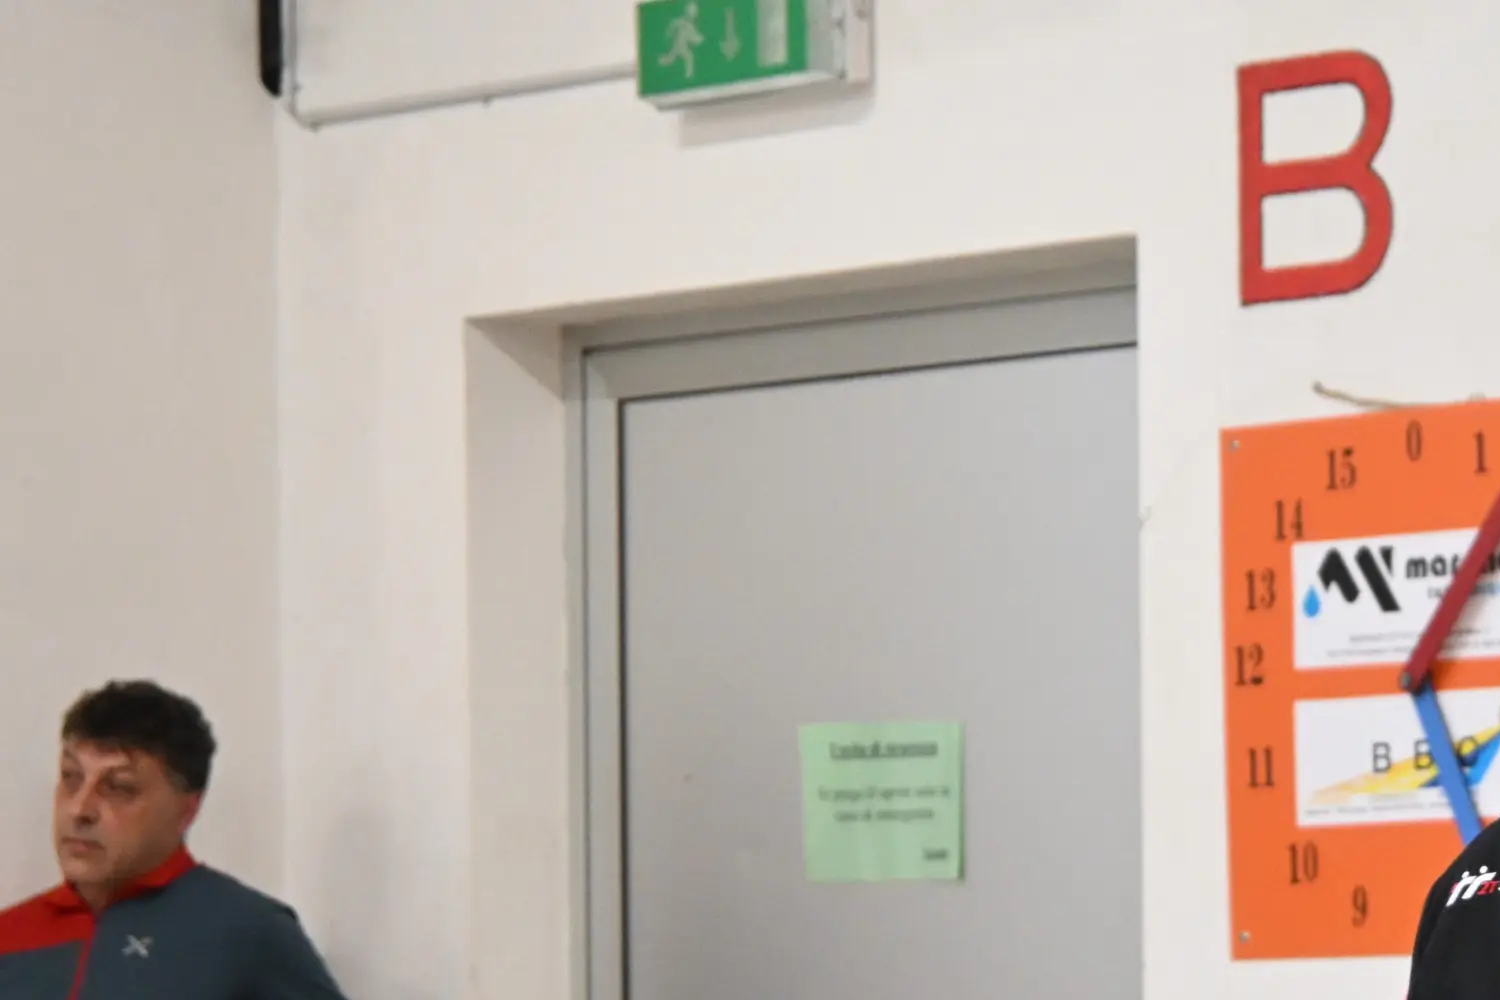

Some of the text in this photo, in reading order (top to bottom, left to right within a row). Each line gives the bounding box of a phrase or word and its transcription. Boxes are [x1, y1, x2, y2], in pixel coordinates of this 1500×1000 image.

[1237, 49, 1394, 305] B
[1406, 421, 1423, 461] 0
[1474, 430, 1488, 475] 1
[1326, 446, 1357, 491] 15
[1275, 499, 1304, 541] 14
[1246, 569, 1276, 612] 13
[1236, 643, 1265, 687] 12
[1248, 746, 1275, 789] 11
[1288, 842, 1320, 885] 10
[1352, 886, 1369, 926] 9
